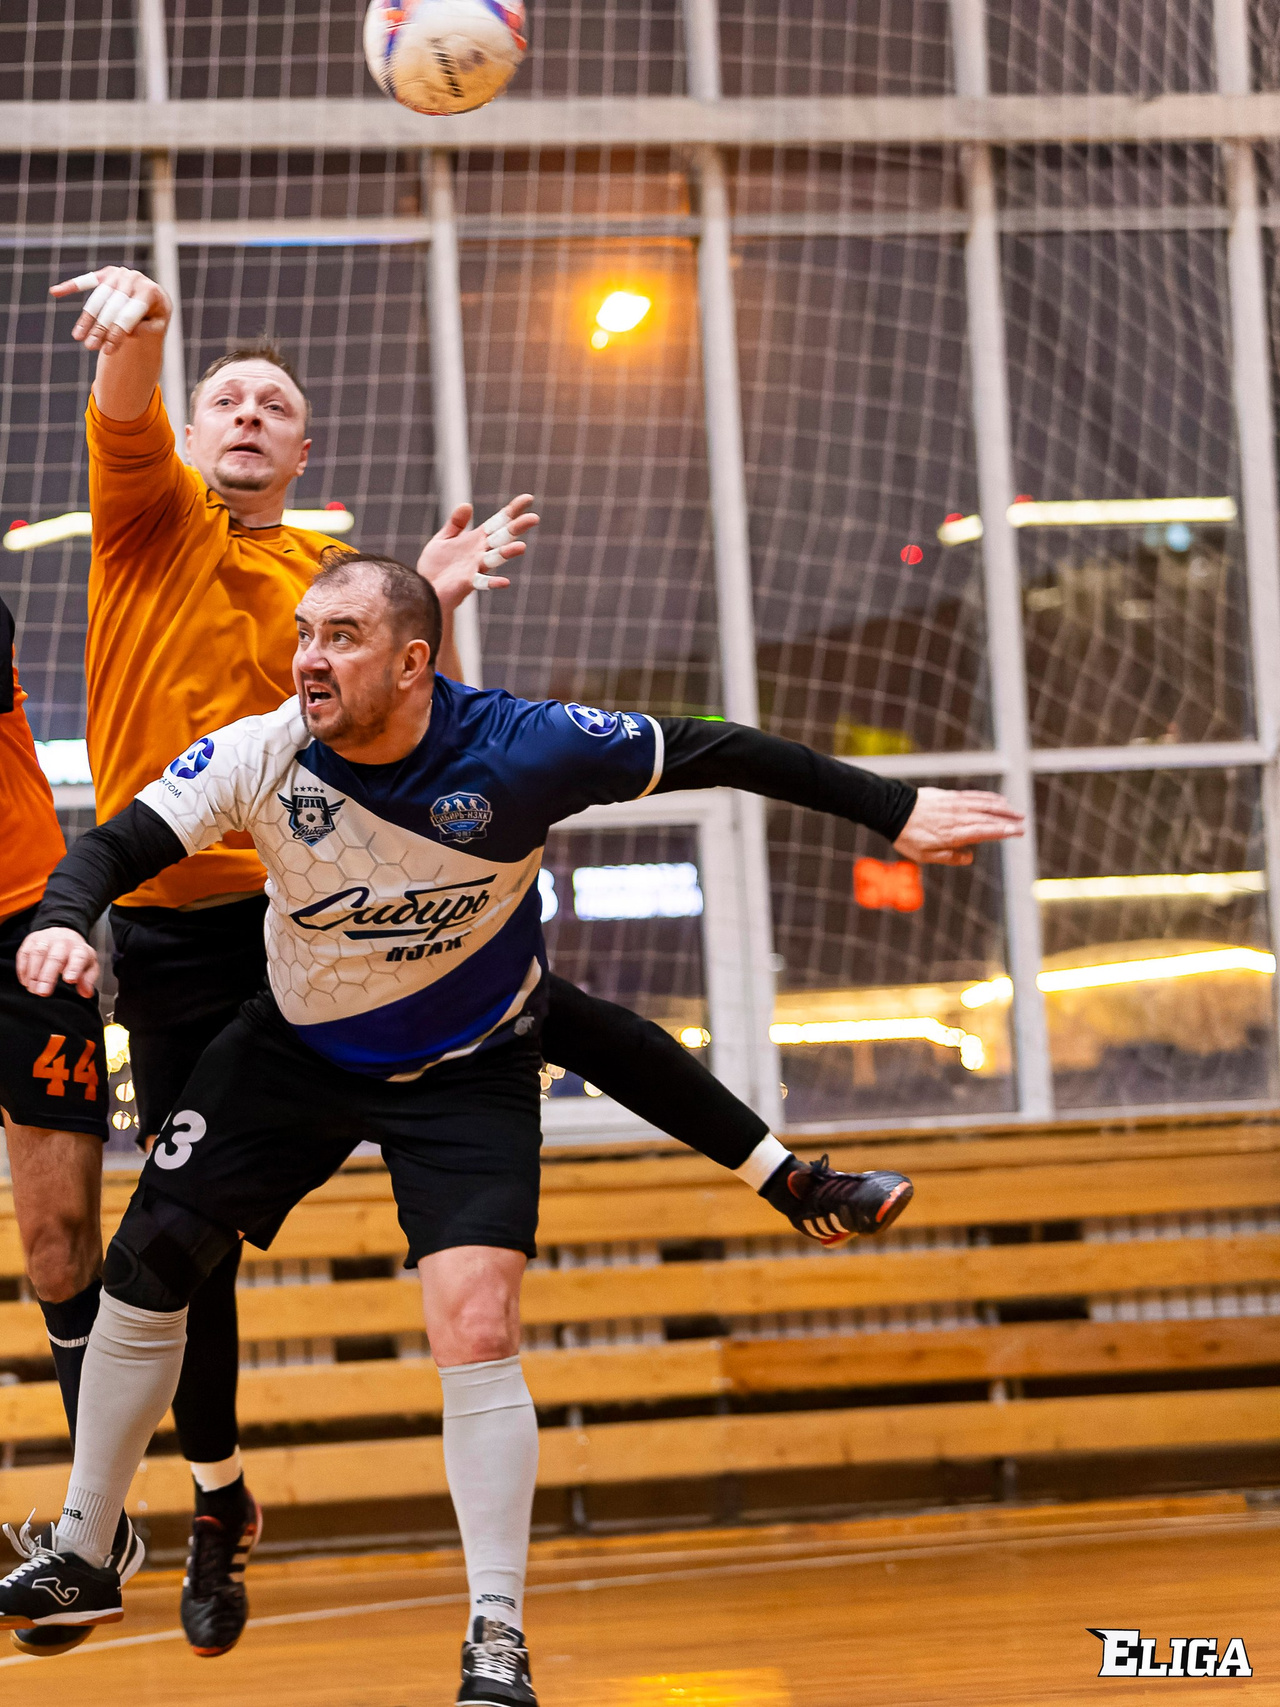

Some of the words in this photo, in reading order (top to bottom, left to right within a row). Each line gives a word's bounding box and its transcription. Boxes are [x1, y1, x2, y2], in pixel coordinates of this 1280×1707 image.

[160, 777, 183, 799] АТОМ
[289, 873, 498, 941] Сибирь
[32, 1034, 99, 1101] 44
